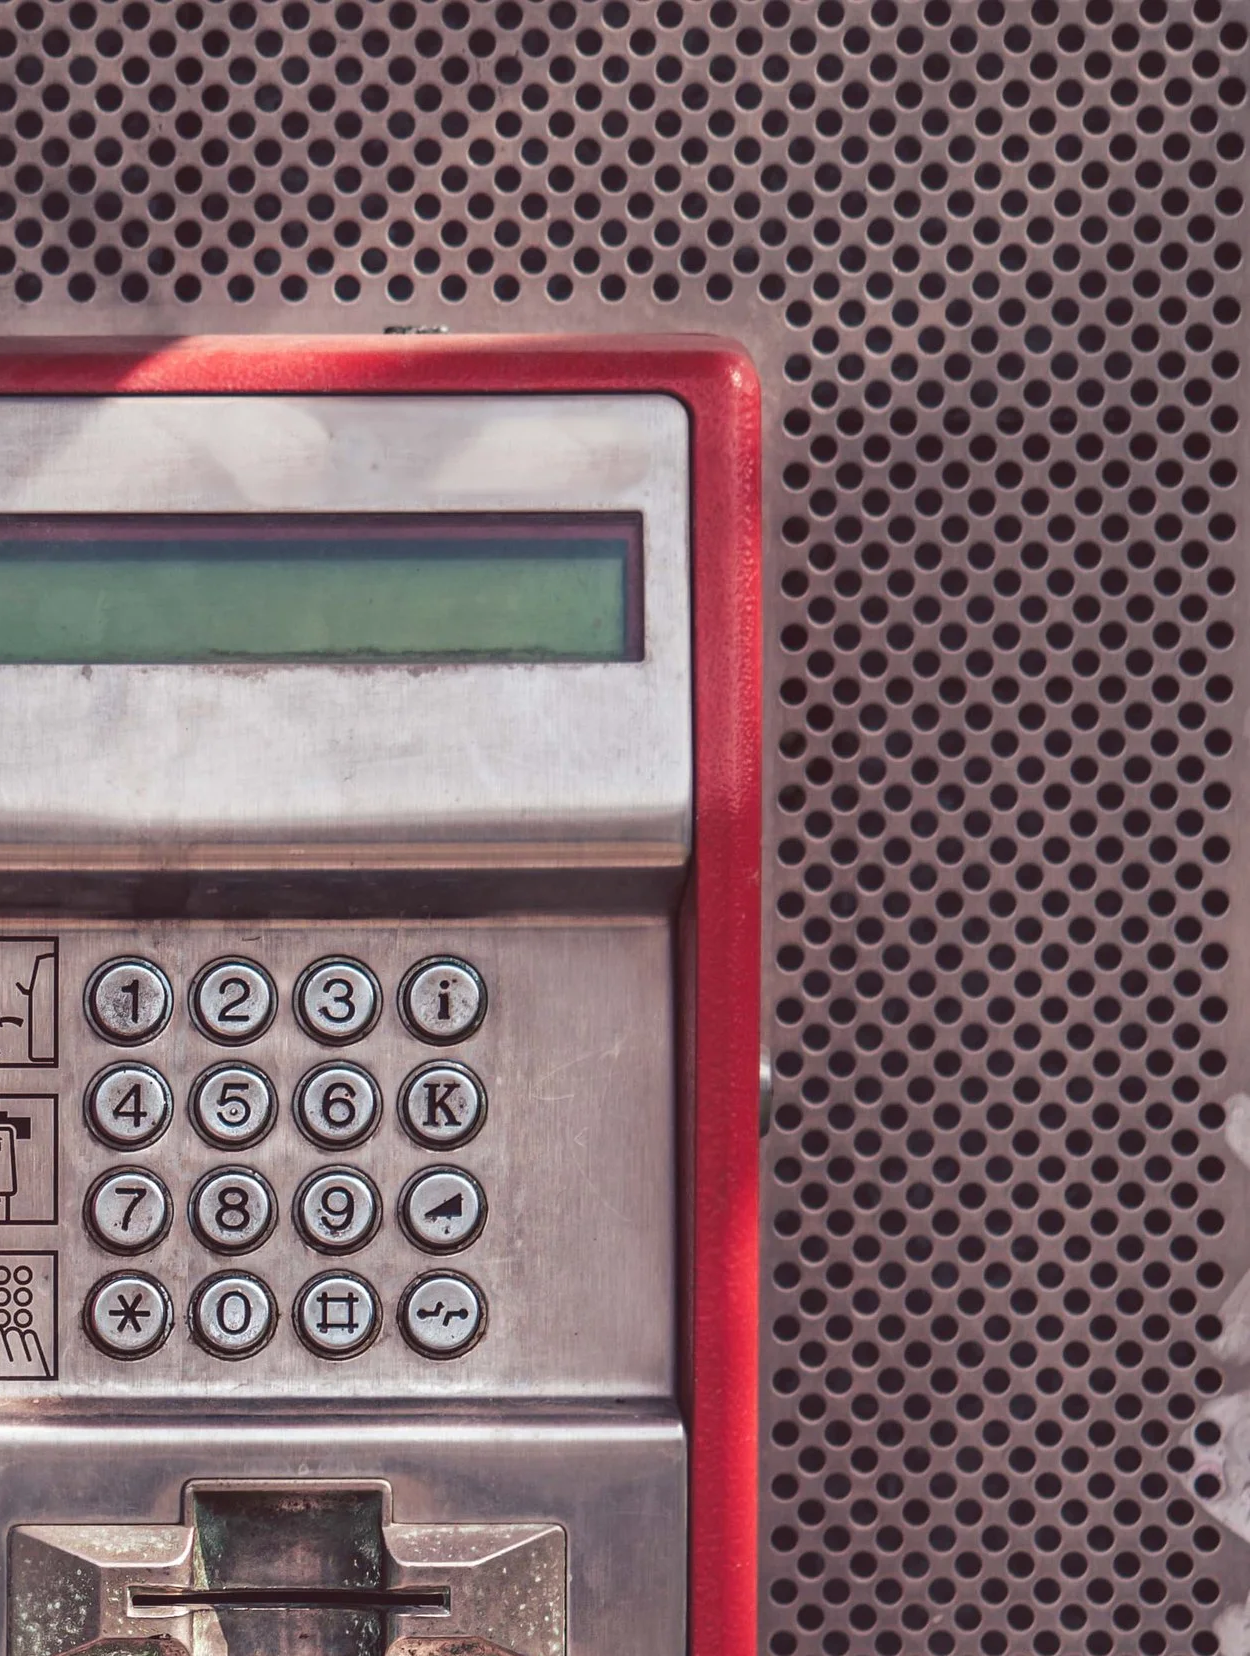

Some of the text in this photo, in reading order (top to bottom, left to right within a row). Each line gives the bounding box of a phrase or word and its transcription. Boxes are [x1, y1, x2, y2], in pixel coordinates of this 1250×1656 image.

[121, 978, 450, 1023] 1 2 3 i
[112, 1082, 462, 1127] 4 5 6 K
[115, 1186, 355, 1231] 7 8 9
[216, 1291, 251, 1335] 0
